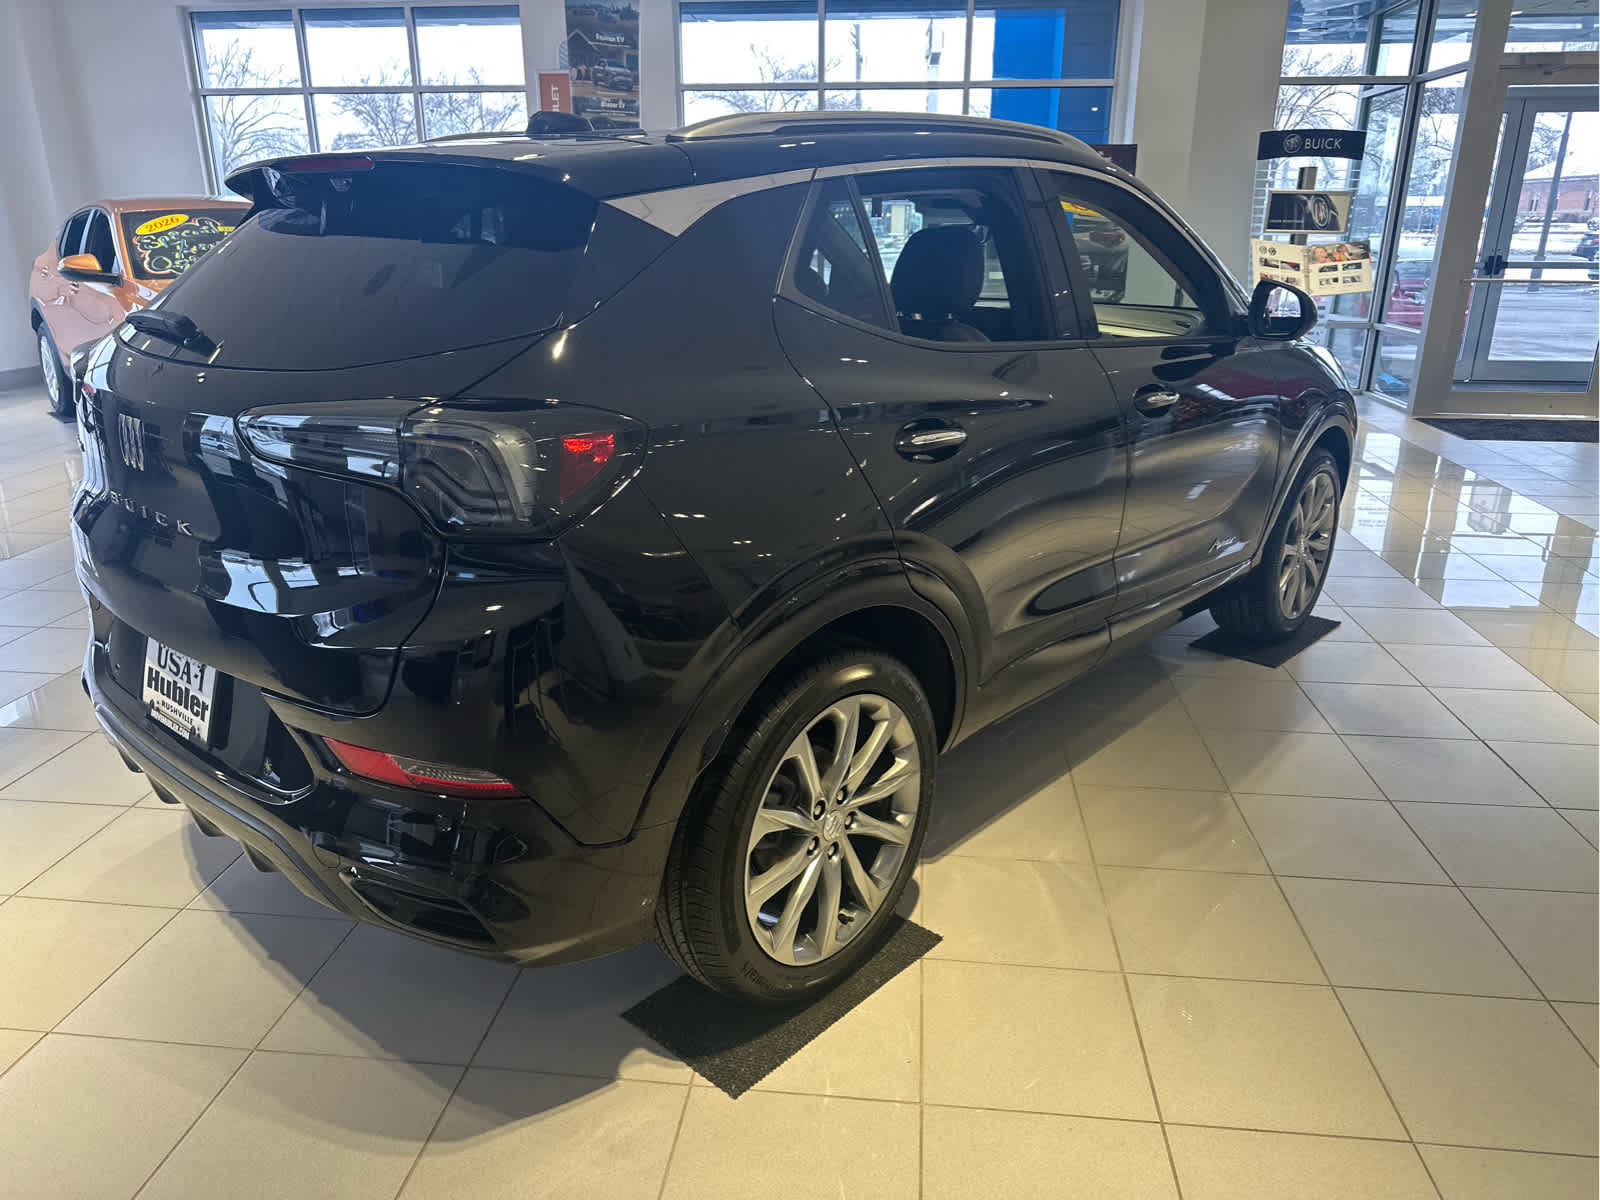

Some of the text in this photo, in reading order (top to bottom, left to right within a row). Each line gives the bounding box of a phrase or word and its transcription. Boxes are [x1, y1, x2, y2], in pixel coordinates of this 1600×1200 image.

[1304, 137, 1343, 150] BUICK
[145, 215, 181, 232] 2026
[110, 490, 193, 536] BUICK
[146, 666, 209, 722] Hubler
[161, 700, 193, 725] RUSHVILLE
